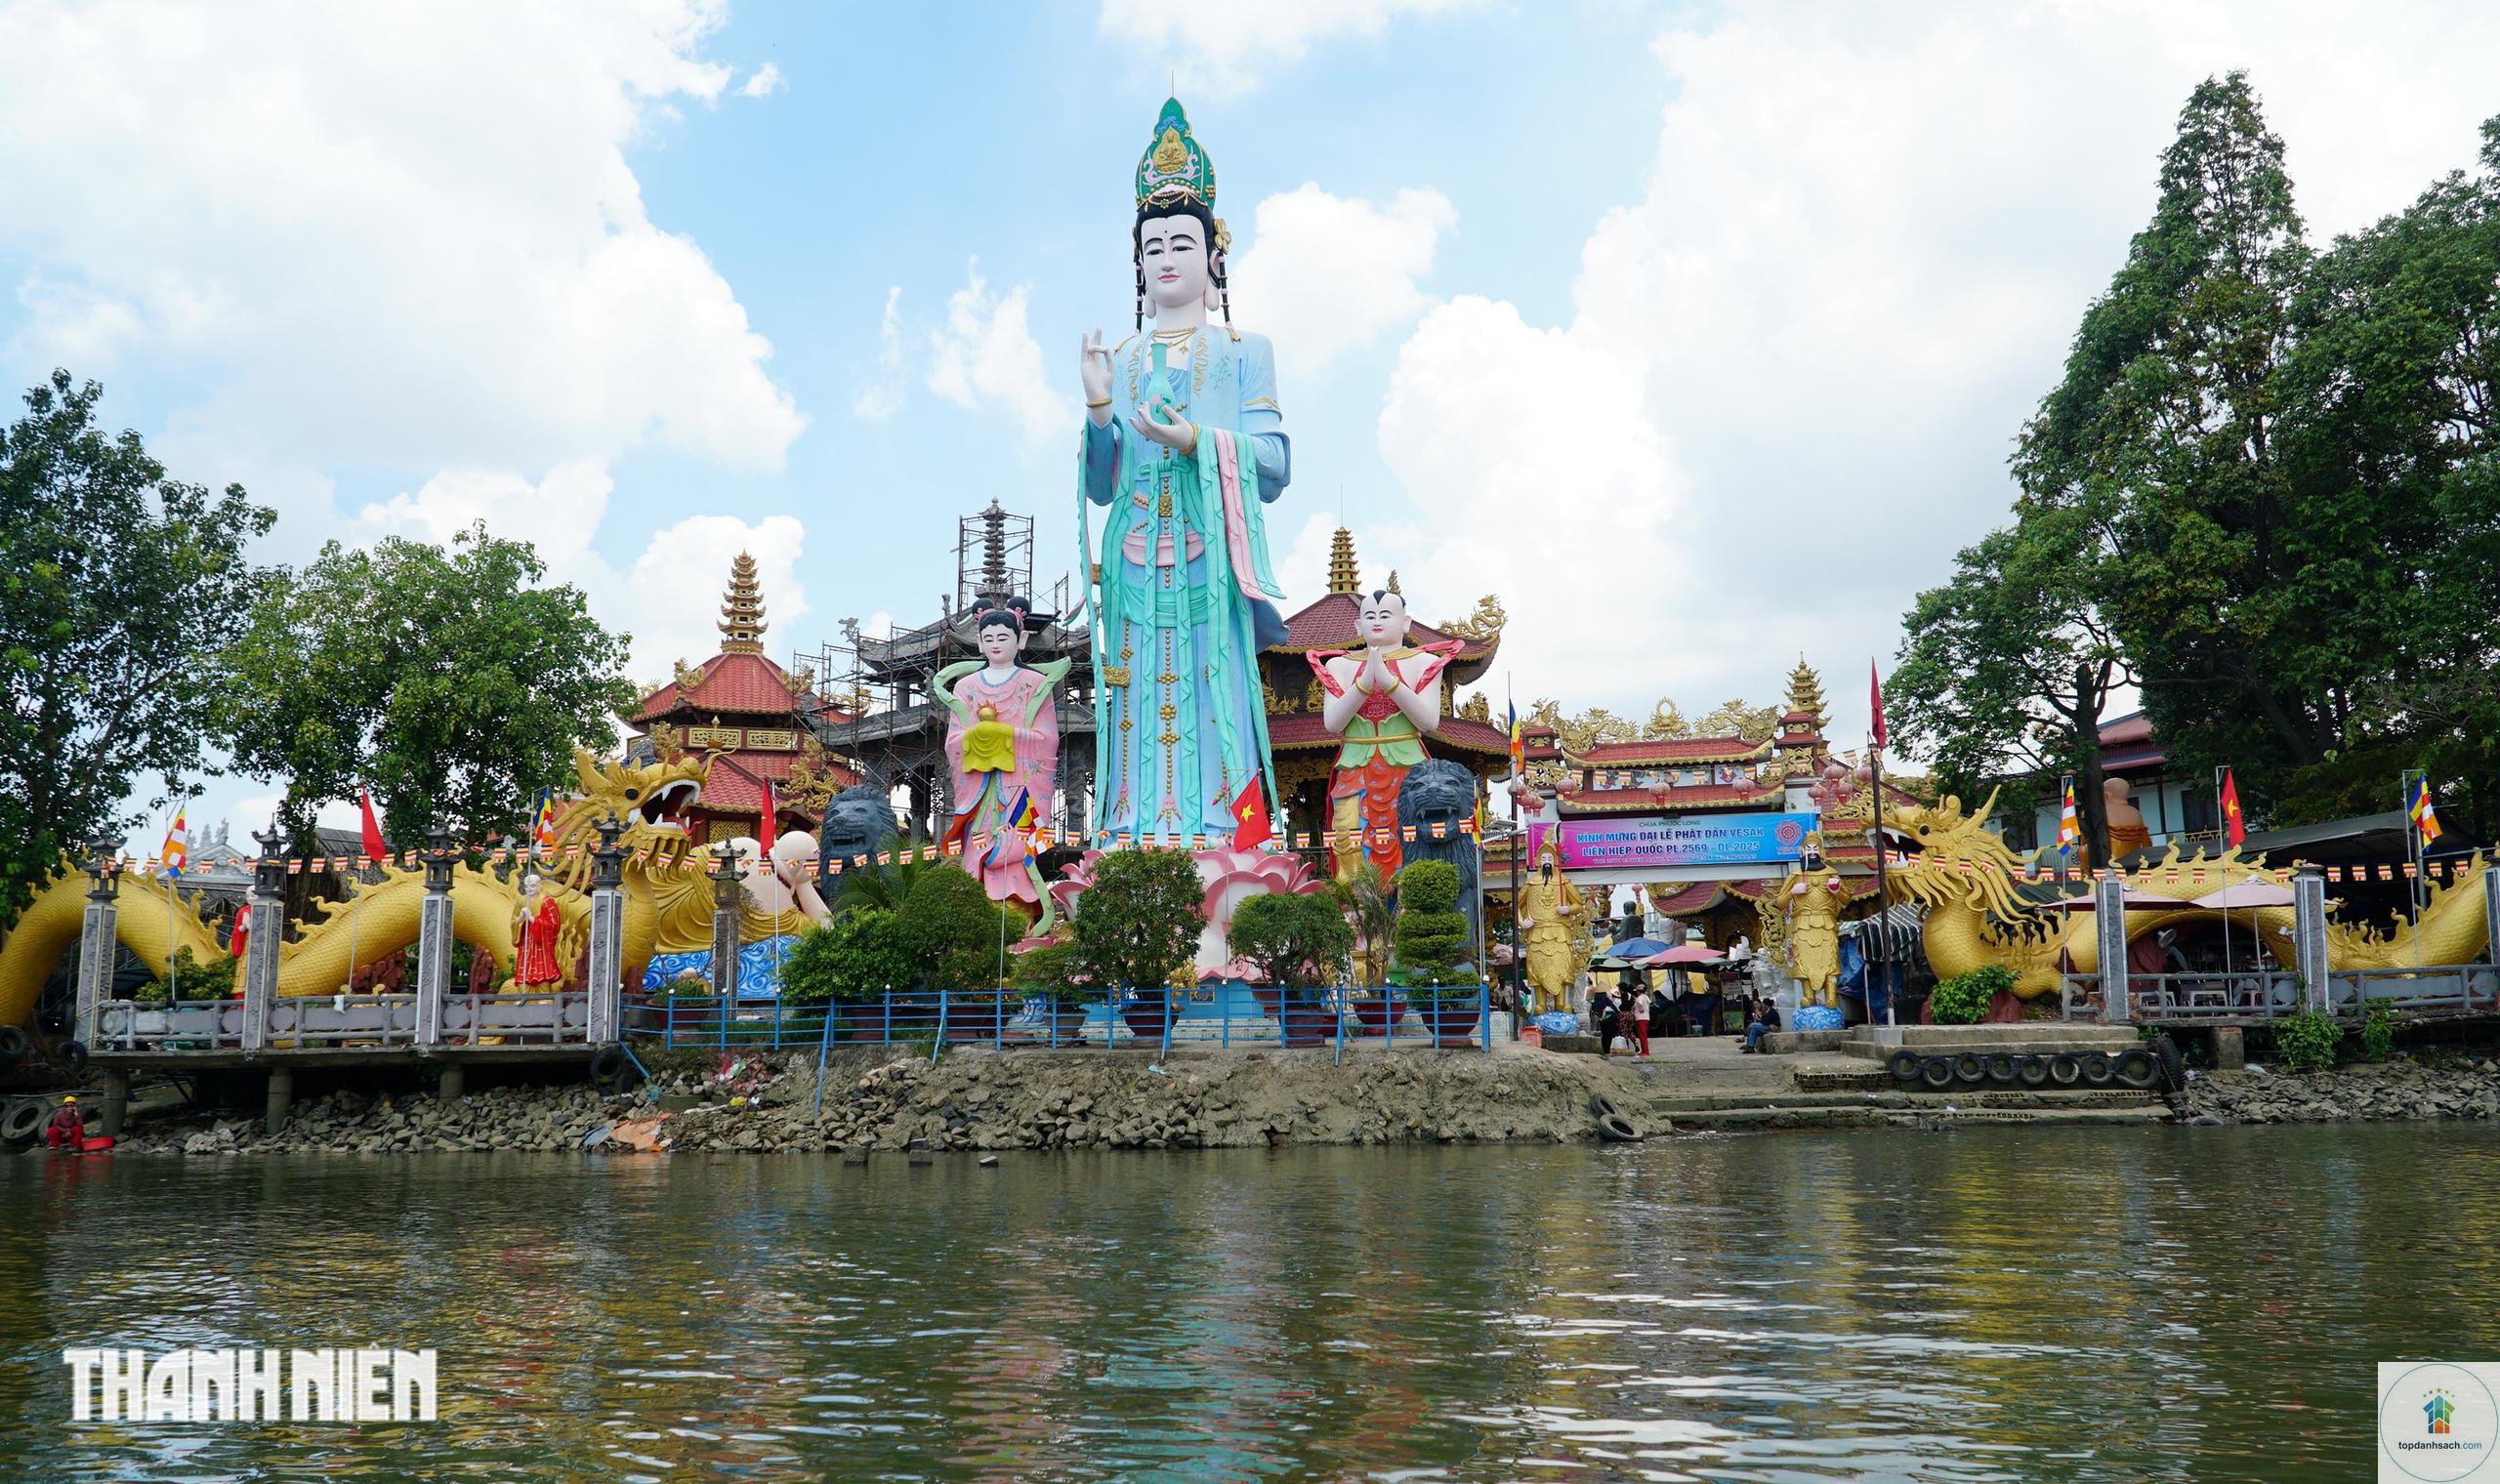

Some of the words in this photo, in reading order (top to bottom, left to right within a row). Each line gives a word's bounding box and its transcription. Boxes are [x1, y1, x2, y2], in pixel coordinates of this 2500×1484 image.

[1729, 828, 1765, 838] VESAK
[1666, 844, 1707, 853] PL.2569
[1718, 842, 1760, 852] DL.2025
